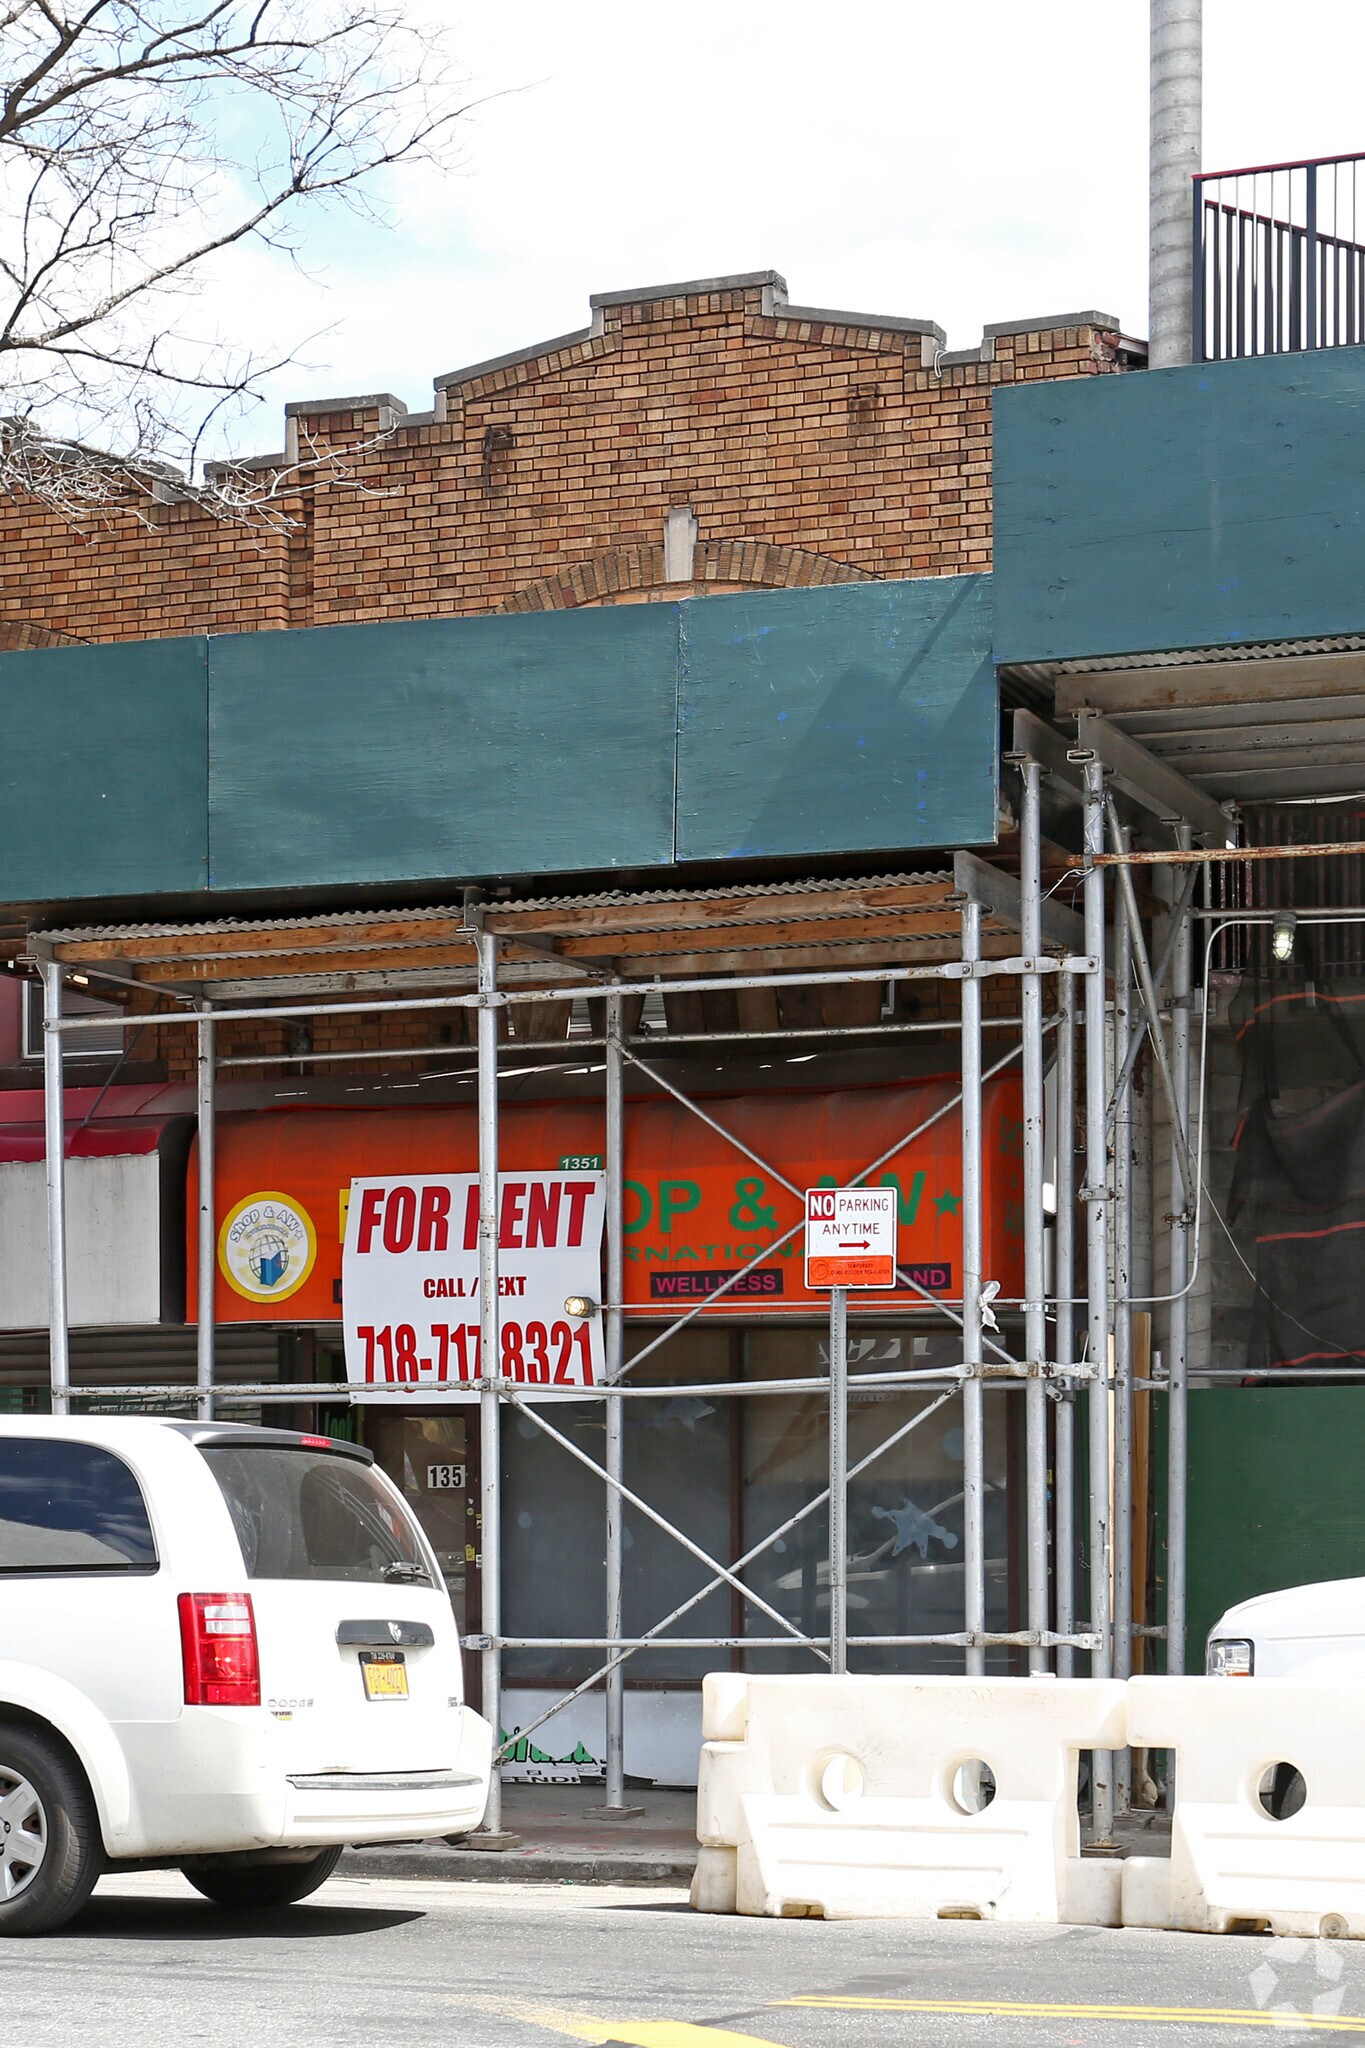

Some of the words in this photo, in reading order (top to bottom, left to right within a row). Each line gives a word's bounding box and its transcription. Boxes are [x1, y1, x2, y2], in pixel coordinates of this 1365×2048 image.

[561, 1157, 598, 1170] 1351
[263, 1205, 275, 1218] &
[729, 1177, 780, 1232] &
[810, 1195, 835, 1217] NO
[839, 1198, 889, 1212] PARKING
[357, 1185, 451, 1254] FOR
[822, 1222, 881, 1236] ANYTIME
[423, 1277, 466, 1298] CALL
[497, 1276, 527, 1296] EXT
[656, 1274, 777, 1293] WELLNESS
[357, 1320, 594, 1393] 718-7178321
[429, 1466, 462, 1487] 135
[268, 1698, 314, 1708] DODGE
